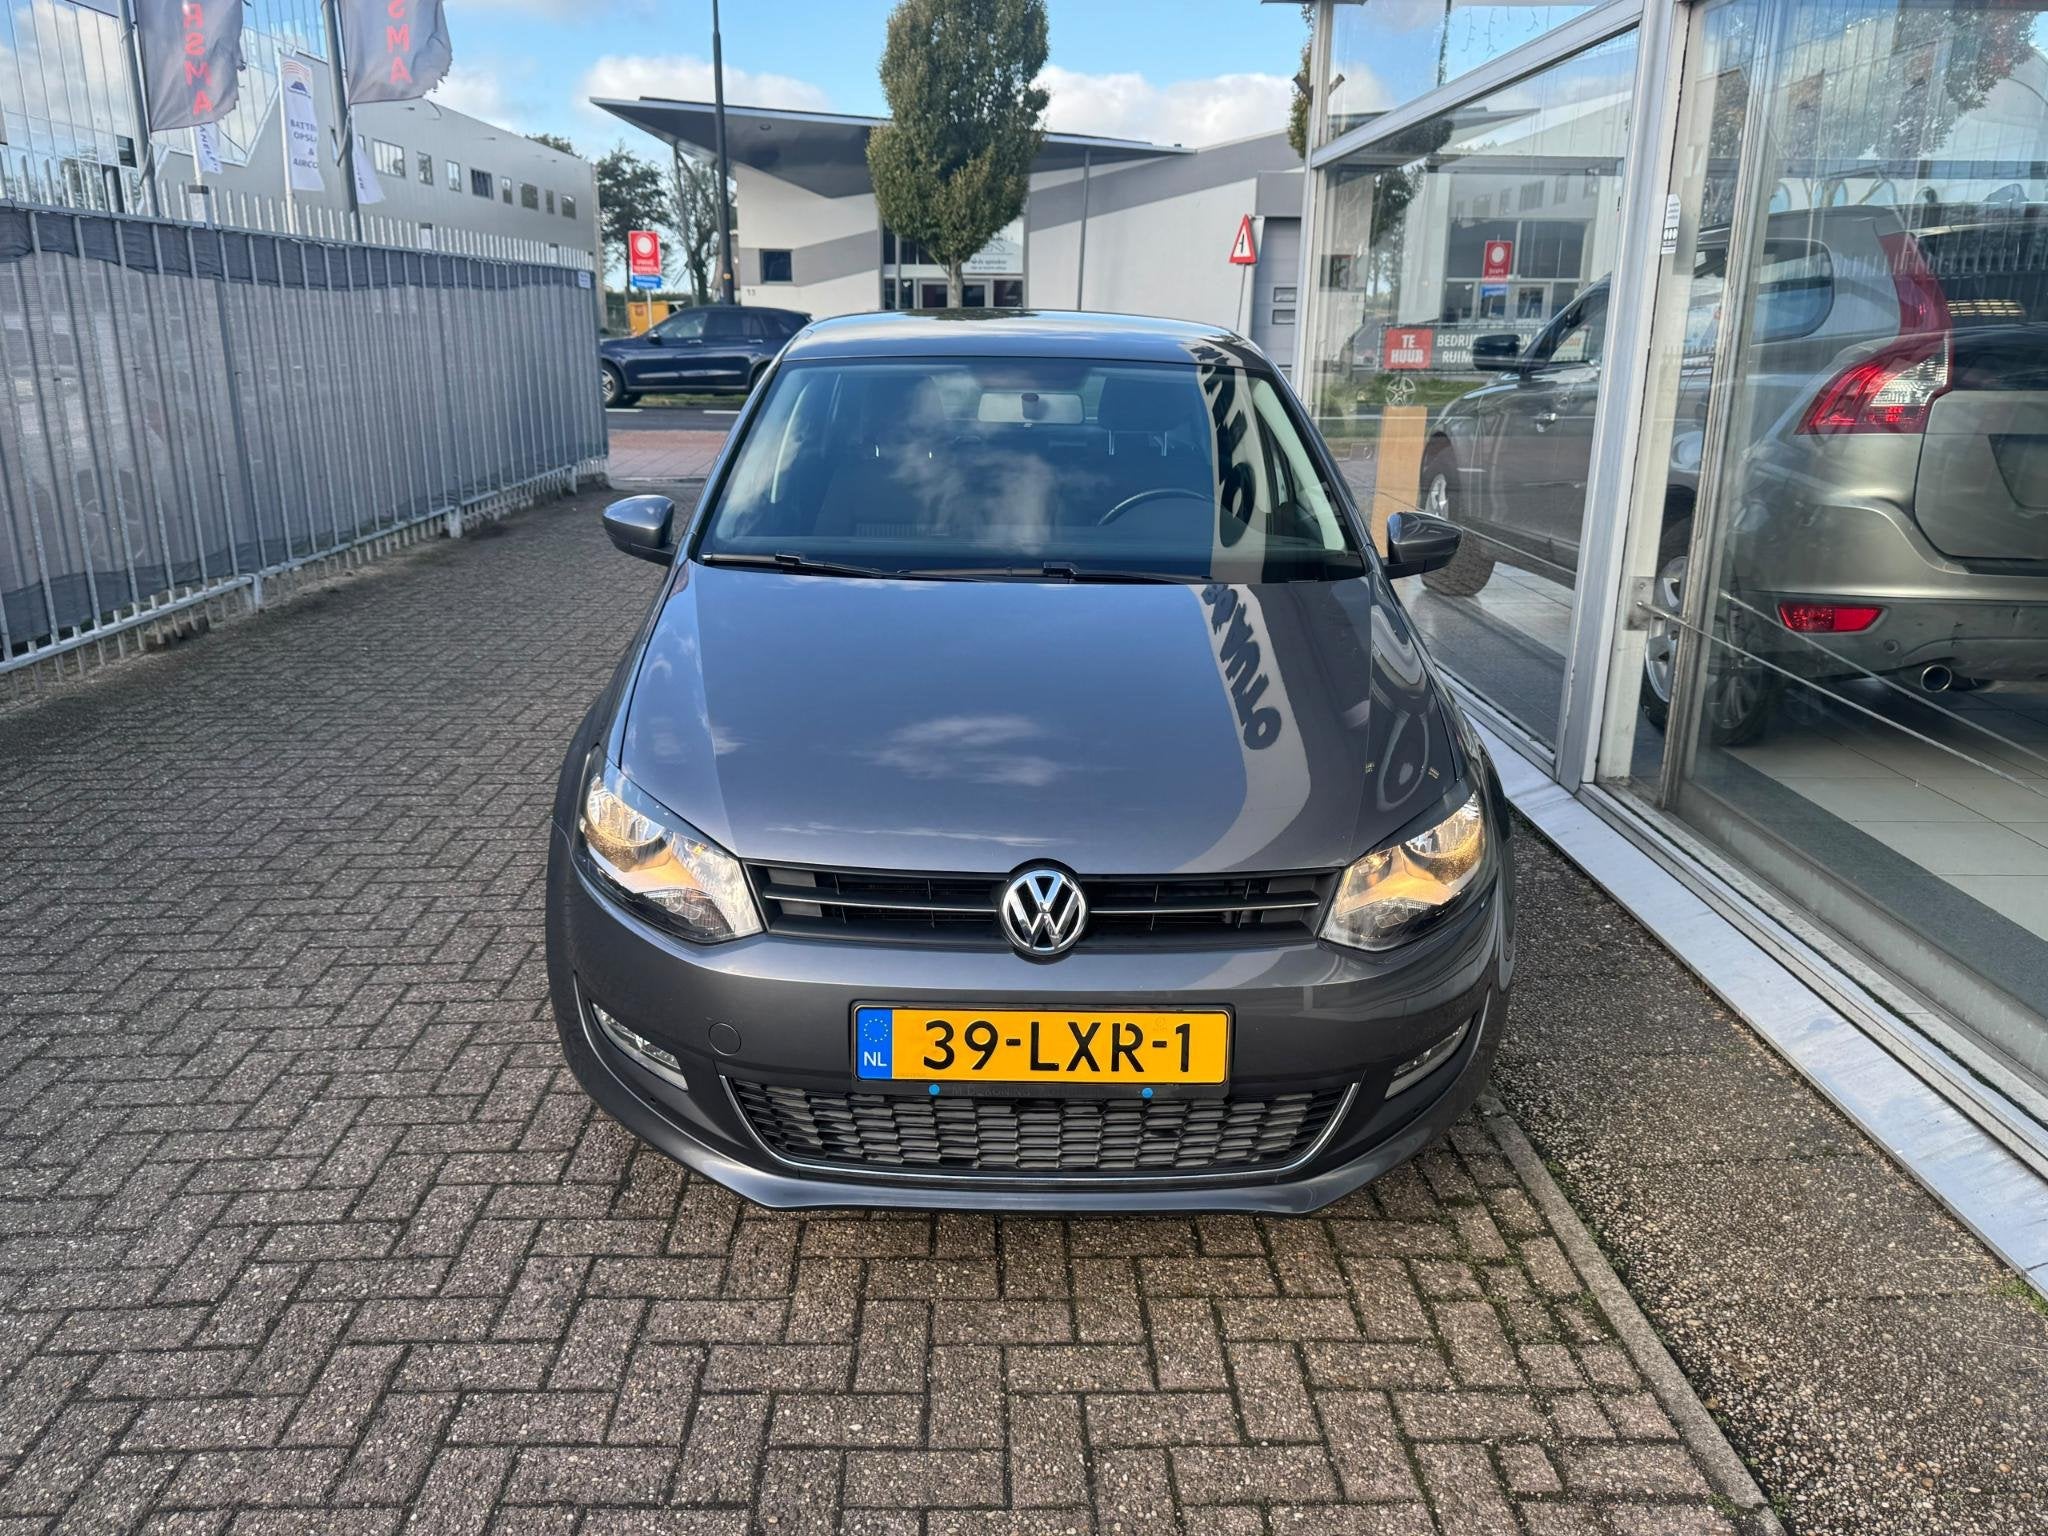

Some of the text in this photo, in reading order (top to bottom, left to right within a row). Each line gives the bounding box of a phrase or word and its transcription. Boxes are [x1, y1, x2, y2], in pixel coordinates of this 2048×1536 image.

[1401, 334, 1416, 348] TE
[1390, 349, 1424, 364] HUUR
[1441, 350, 1474, 364] RUIM
[923, 1019, 1191, 1073] 39-LXR-1
[863, 1051, 888, 1068] NL
